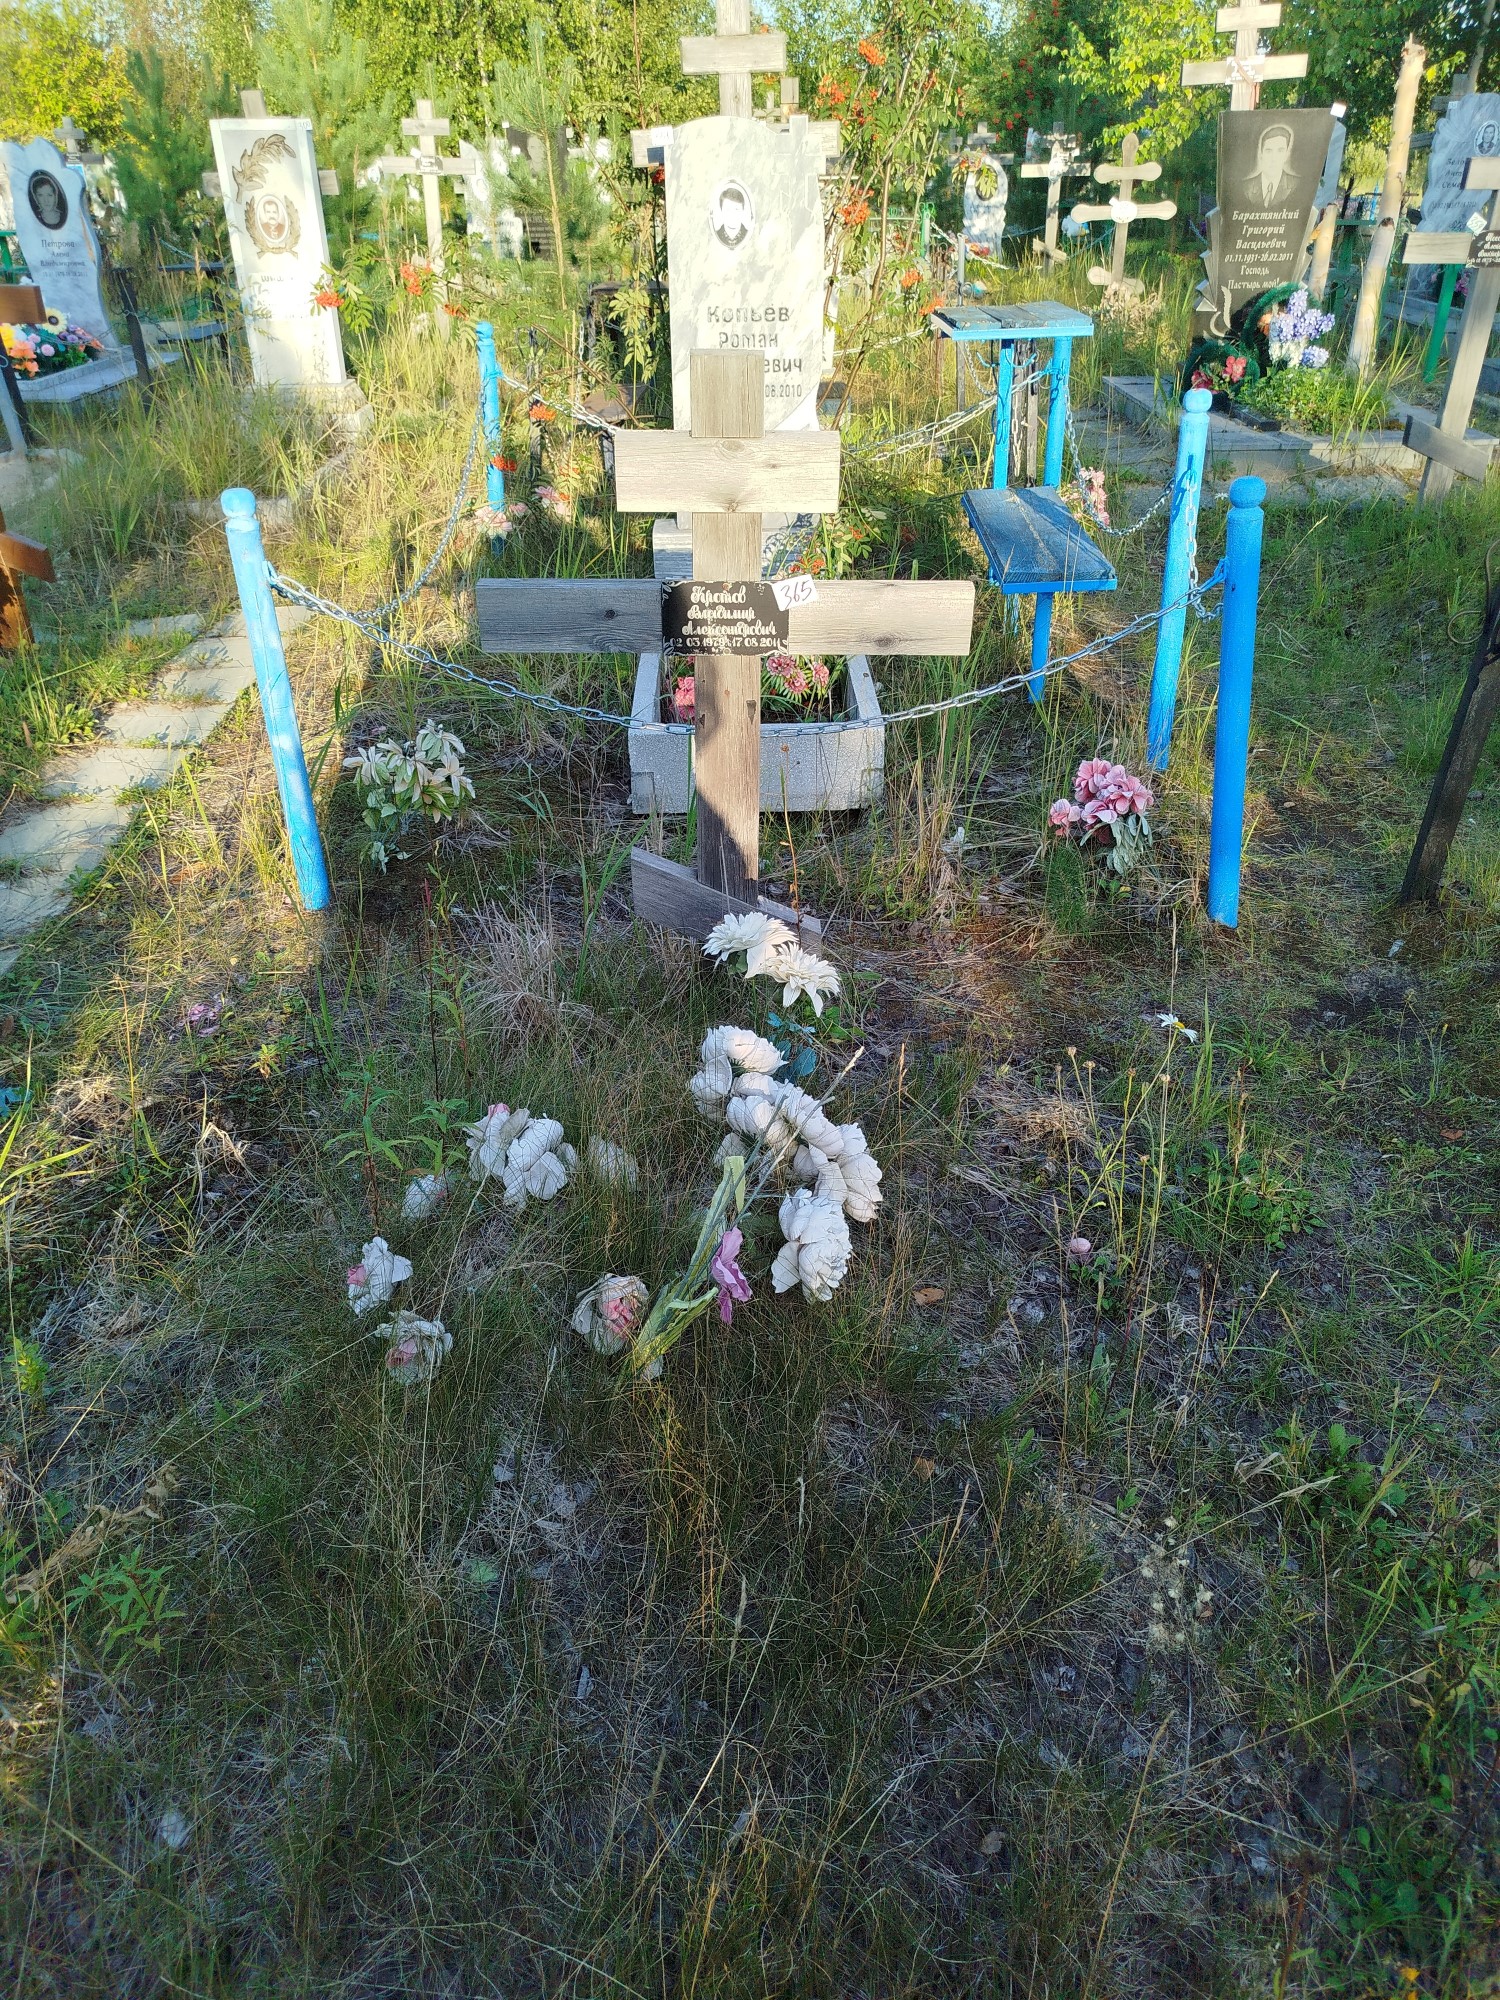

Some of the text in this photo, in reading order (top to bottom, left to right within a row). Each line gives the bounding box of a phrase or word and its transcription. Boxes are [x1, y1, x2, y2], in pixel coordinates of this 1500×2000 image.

[1232, 209, 1300, 223] Барахтянский
[1242, 224, 1286, 237] Григорий
[1235, 239, 1287, 249] Васильевич
[1240, 264, 1270, 276] Господь
[1228, 279, 1261, 291] Пастырь
[764, 358, 803, 373] евич
[690, 585, 747, 607] Кротов
[780, 580, 813, 610] 365
[687, 605, 756, 624] Владимир
